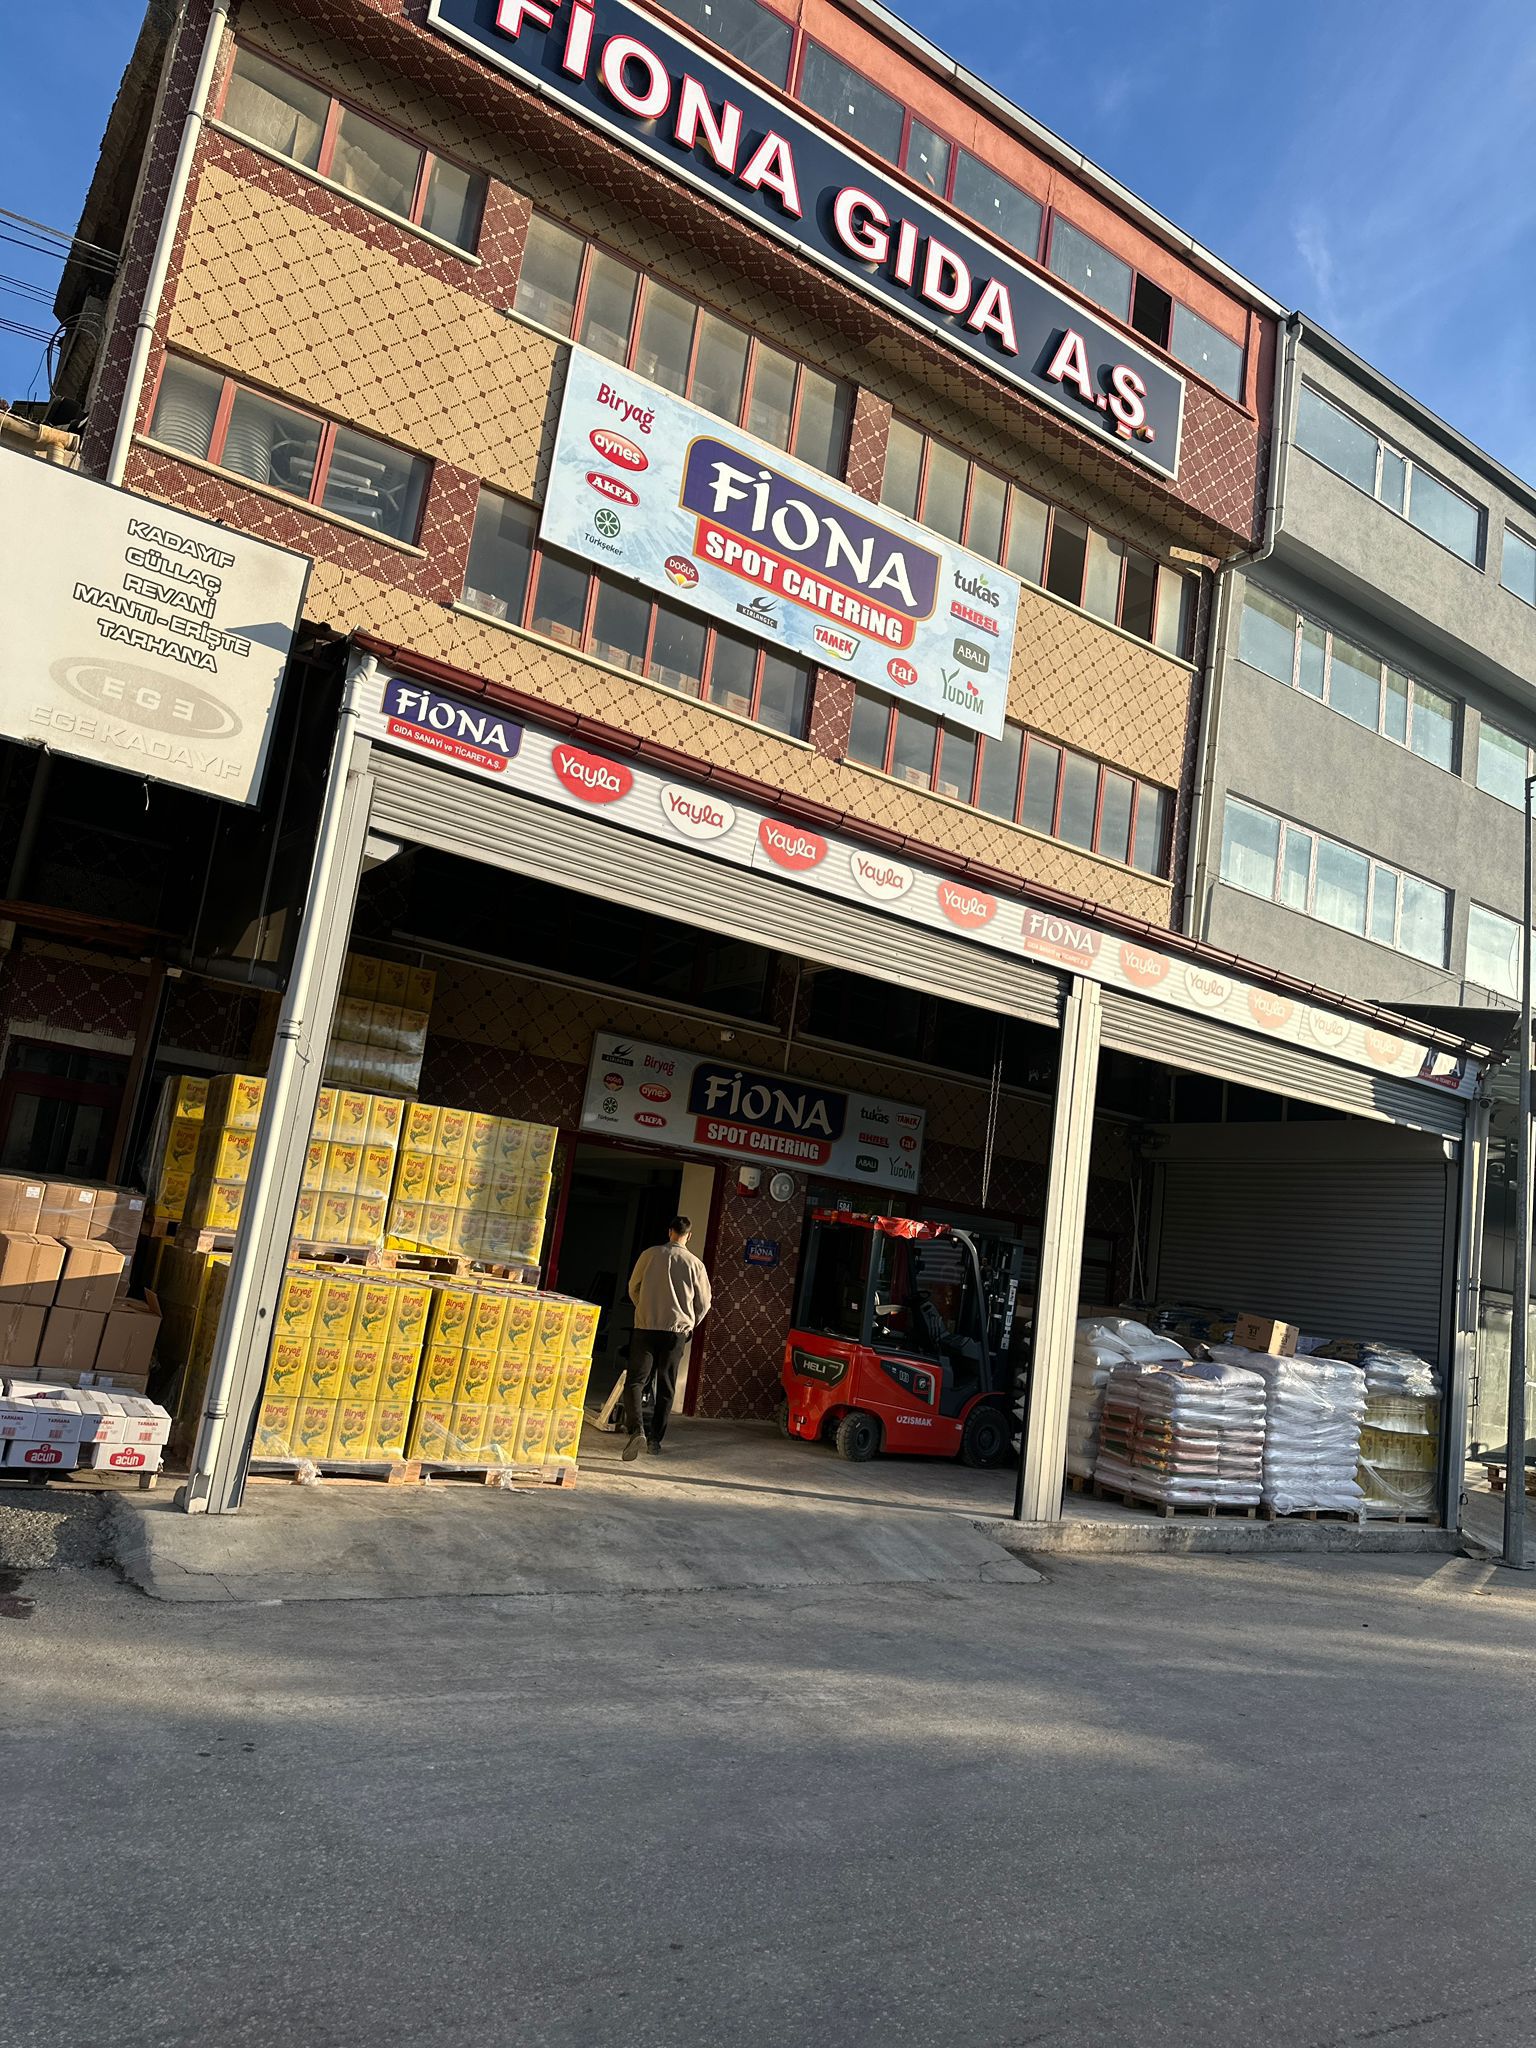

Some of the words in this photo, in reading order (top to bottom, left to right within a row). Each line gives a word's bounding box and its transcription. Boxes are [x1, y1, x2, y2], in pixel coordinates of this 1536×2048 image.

[832, 186, 1020, 357] GIDA
[1047, 329, 1157, 446] A.Ş.
[596, 383, 655, 434] Biryağ
[594, 431, 641, 466] aynes
[591, 475, 634, 505] AKFA
[127, 518, 236, 569] KADAYIF
[708, 461, 918, 607] FİONA
[584, 532, 624, 557] Türkşeker
[705, 530, 779, 585] SPOT
[125, 546, 222, 596] GÜLLAÇ
[669, 559, 696, 578] DOĞUŞ
[123, 573, 217, 619] REVANİ
[953, 570, 1000, 608] tukaş
[950, 600, 1000, 634] AKBEL
[97, 618, 218, 673] TARHANA
[815, 628, 854, 654] TAMEK
[957, 645, 987, 667] ABALI
[891, 661, 915, 684] tat
[396, 688, 510, 754] FİONA
[101, 724, 243, 780] KADAYIF
[393, 724, 413, 738] GIDA
[414, 731, 443, 748] SANAYİ
[444, 743, 453, 752] ve
[455, 745, 487, 764] TİCARET
[559, 752, 621, 793] Yayla
[668, 792, 724, 829] Yayla
[764, 825, 817, 860] Yayla
[857, 857, 904, 890] Yayla
[943, 887, 988, 919] Yayla
[1030, 914, 1095, 954] FİONA
[1124, 949, 1162, 976] Yayla
[1190, 972, 1226, 997] Yayla
[1253, 995, 1287, 1019] Yayla
[644, 1055, 676, 1077] Biryağ
[238, 1083, 260, 1095] Biryağ
[641, 1086, 667, 1099] aynes
[704, 1072, 833, 1135] FİONA
[414, 1110, 433, 1122] Biryağ
[638, 1114, 663, 1126] AKFA
[228, 1135, 250, 1146] Biryağ
[707, 1123, 748, 1145] SPOT
[335, 1149, 356, 1161] Biryağ
[369, 1153, 390, 1163] Biryağ
[407, 1159, 425, 1170] Biryağ
[438, 1163, 457, 1175] Biryağ
[217, 1187, 239, 1198] Biryağ
[289, 1285, 313, 1298] Biryağ
[327, 1288, 350, 1301] Biryağ
[366, 1292, 388, 1305] Biryağ
[402, 1295, 424, 1307] Biryağ
[445, 1298, 465, 1311] Biryağ
[480, 1302, 500, 1314] Biryağ
[513, 1306, 533, 1317] Biryağ
[278, 1344, 301, 1357] Biryağ
[317, 1347, 340, 1360] Biryağ
[354, 1350, 377, 1361] Biryağ
[391, 1352, 414, 1364] Biryağ
[434, 1354, 455, 1367] Biryağ
[470, 1357, 491, 1370] Biryağ
[803, 1361, 826, 1374] HELI
[265, 1404, 289, 1416] Biryağ
[305, 1406, 328, 1418] Biryağ
[344, 1408, 367, 1421] Biryağ
[382, 1410, 403, 1421] Biryağ
[460, 1413, 481, 1426] Biryağ
[31, 1450, 56, 1463] acun
[115, 1454, 139, 1466] acun
